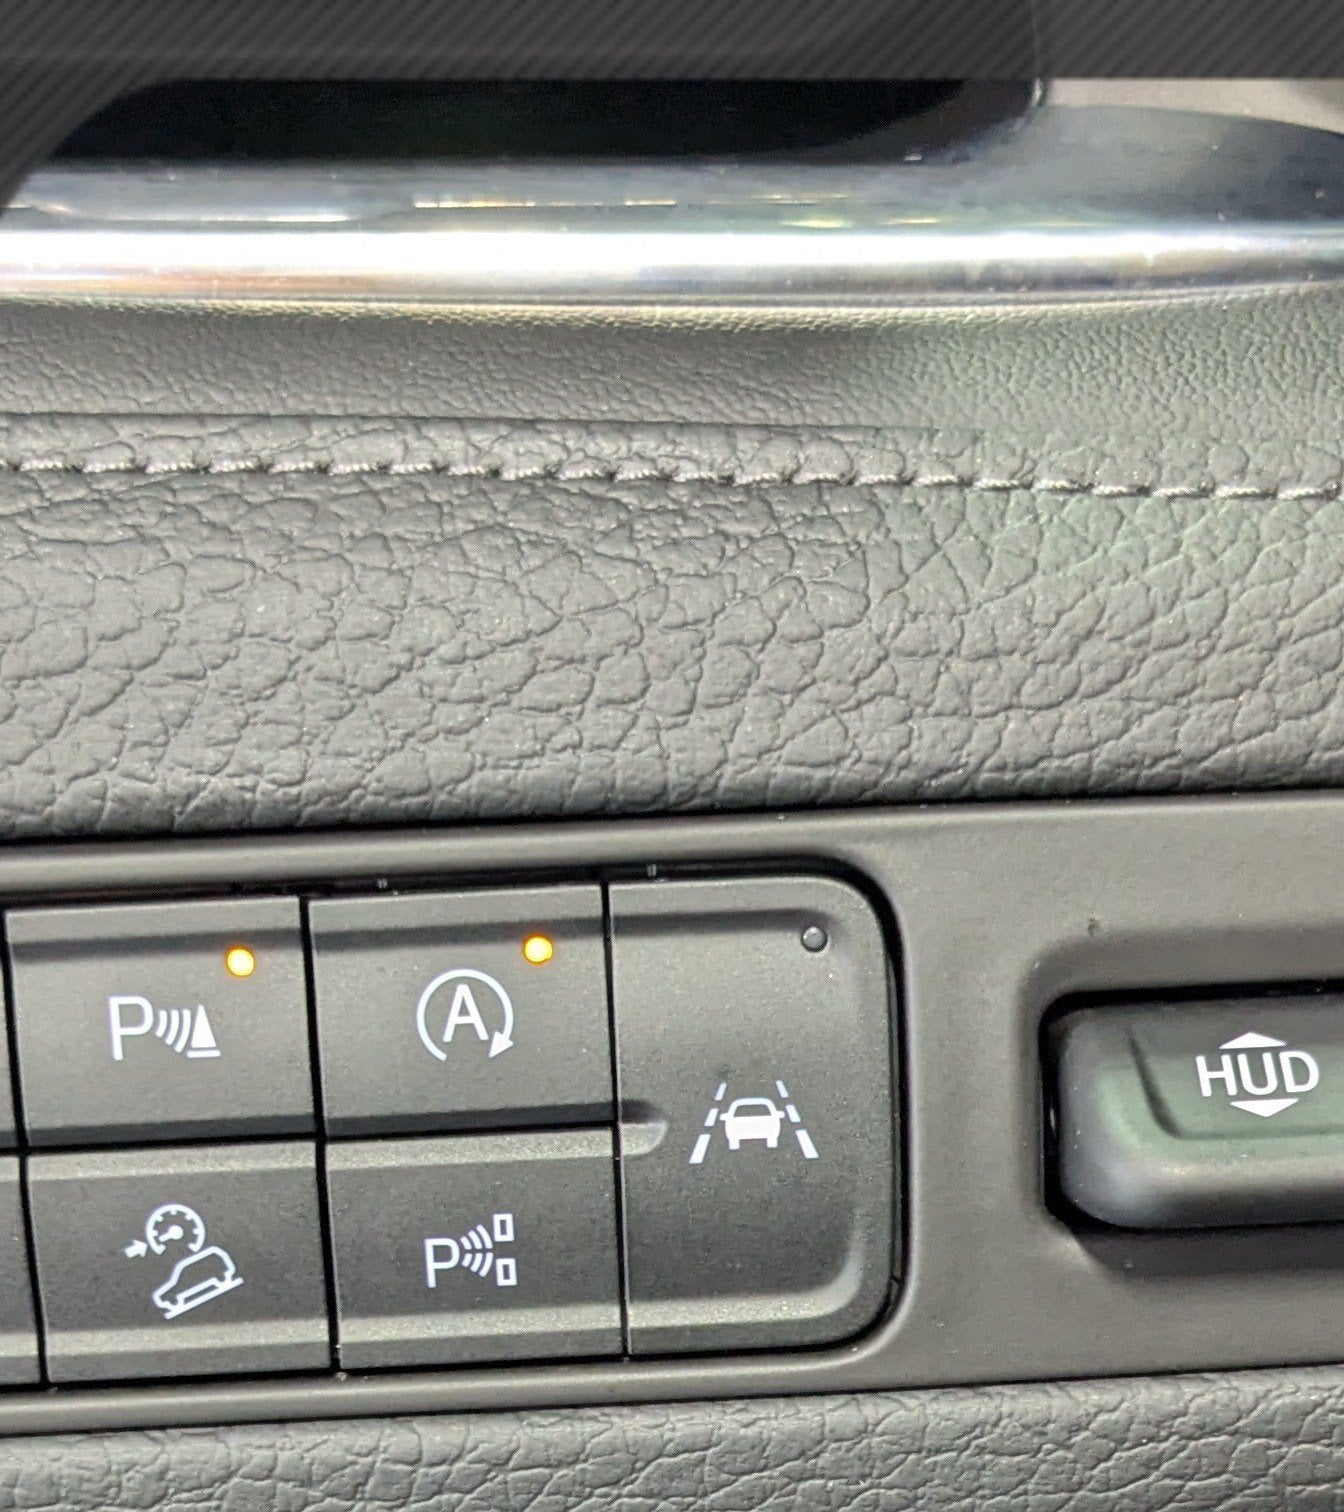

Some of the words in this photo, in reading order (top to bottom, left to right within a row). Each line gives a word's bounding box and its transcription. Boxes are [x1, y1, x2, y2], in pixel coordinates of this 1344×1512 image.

[108, 995, 150, 1061] P
[442, 982, 490, 1042] A
[1195, 1048, 1321, 1099] HUD
[423, 1236, 459, 1288] P
